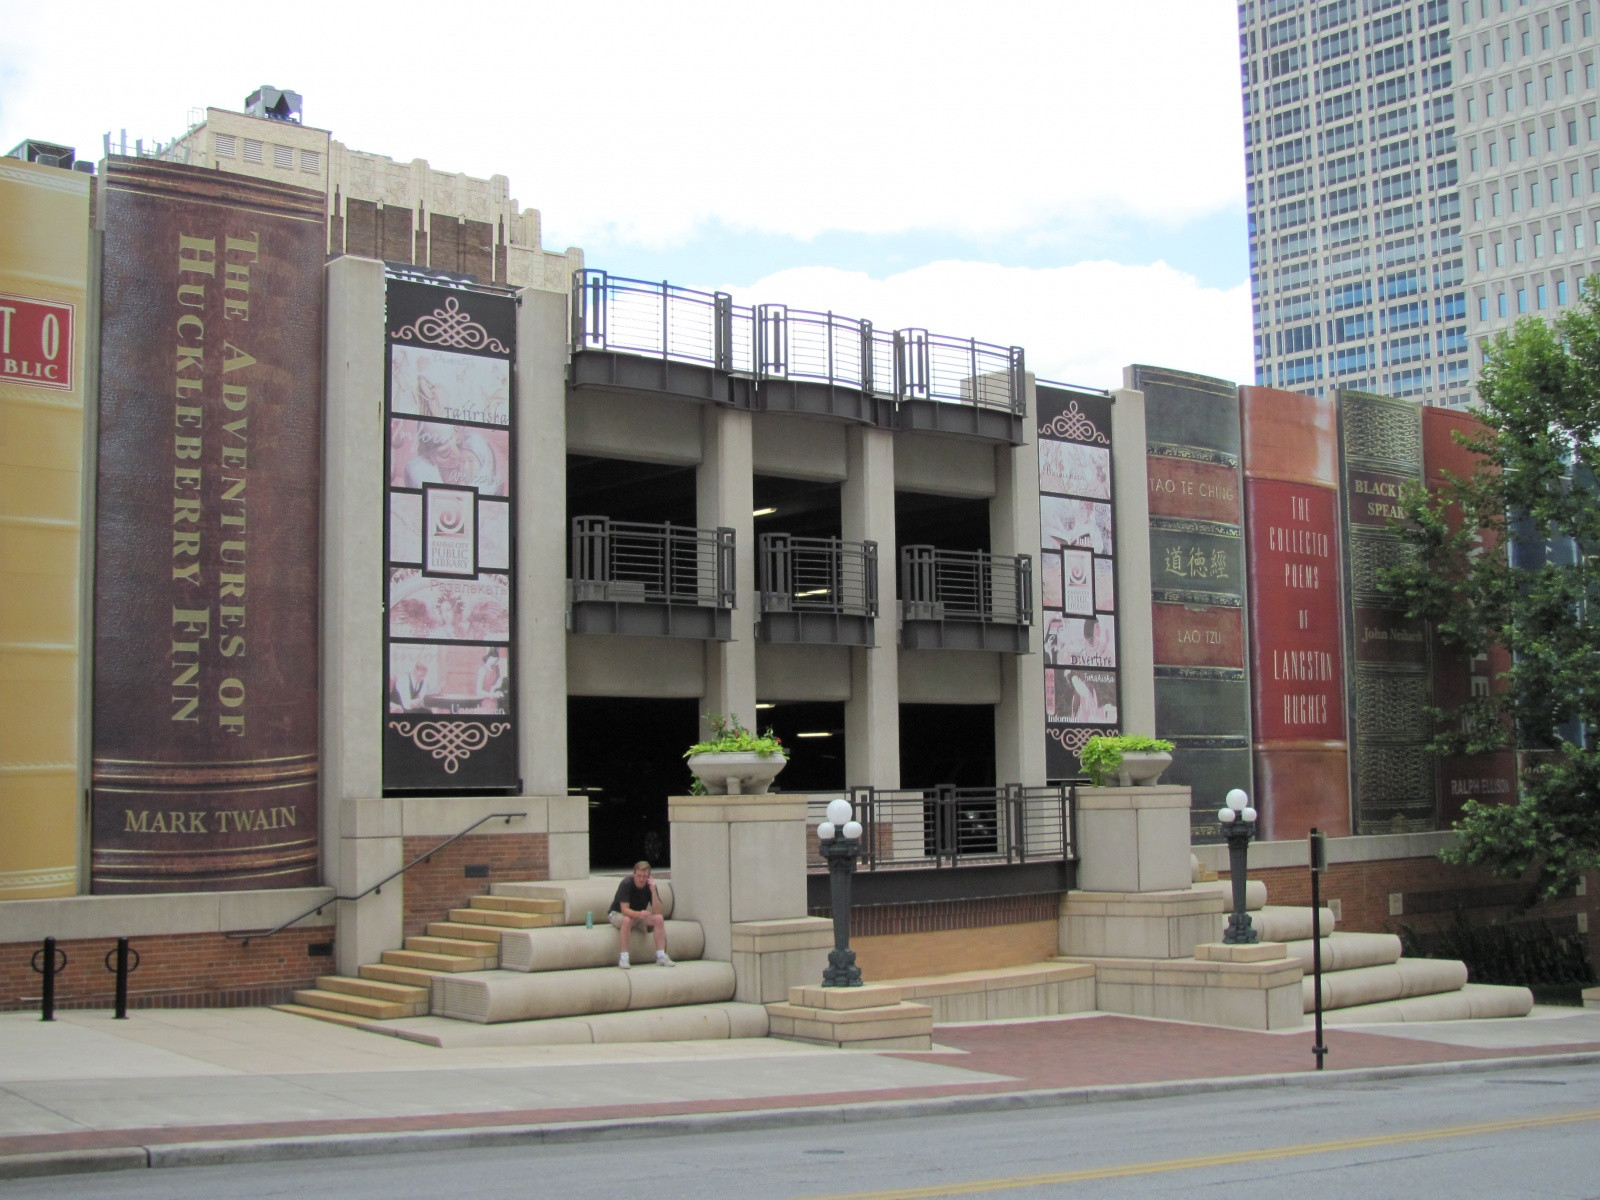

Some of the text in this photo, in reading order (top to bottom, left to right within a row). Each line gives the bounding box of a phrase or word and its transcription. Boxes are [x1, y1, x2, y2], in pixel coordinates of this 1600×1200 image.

[172, 231, 216, 724] HUCKLEBERRY FINN
[218, 231, 259, 737] THE ADVENTURES OF
[1182, 480, 1193, 495] TE
[1199, 484, 1234, 501] CHING
[1354, 479, 1397, 498] BLACK
[1291, 496, 1310, 522] THE
[431, 547, 469, 559] PUBLIC
[1269, 526, 1328, 558] COLLECTED
[431, 557, 469, 569] LIBRARY
[1165, 545, 1229, 579] 道德經
[1285, 563, 1319, 590] POEMS
[1299, 609, 1308, 630] OF
[1178, 629, 1221, 644] LAO TZU
[1362, 627, 1388, 643] John
[1273, 649, 1332, 682] LANGSTON
[1283, 694, 1327, 725] HUGHES
[1451, 778, 1510, 795] RALPH ELLISON
[124, 805, 297, 834] MARK TWAIN
